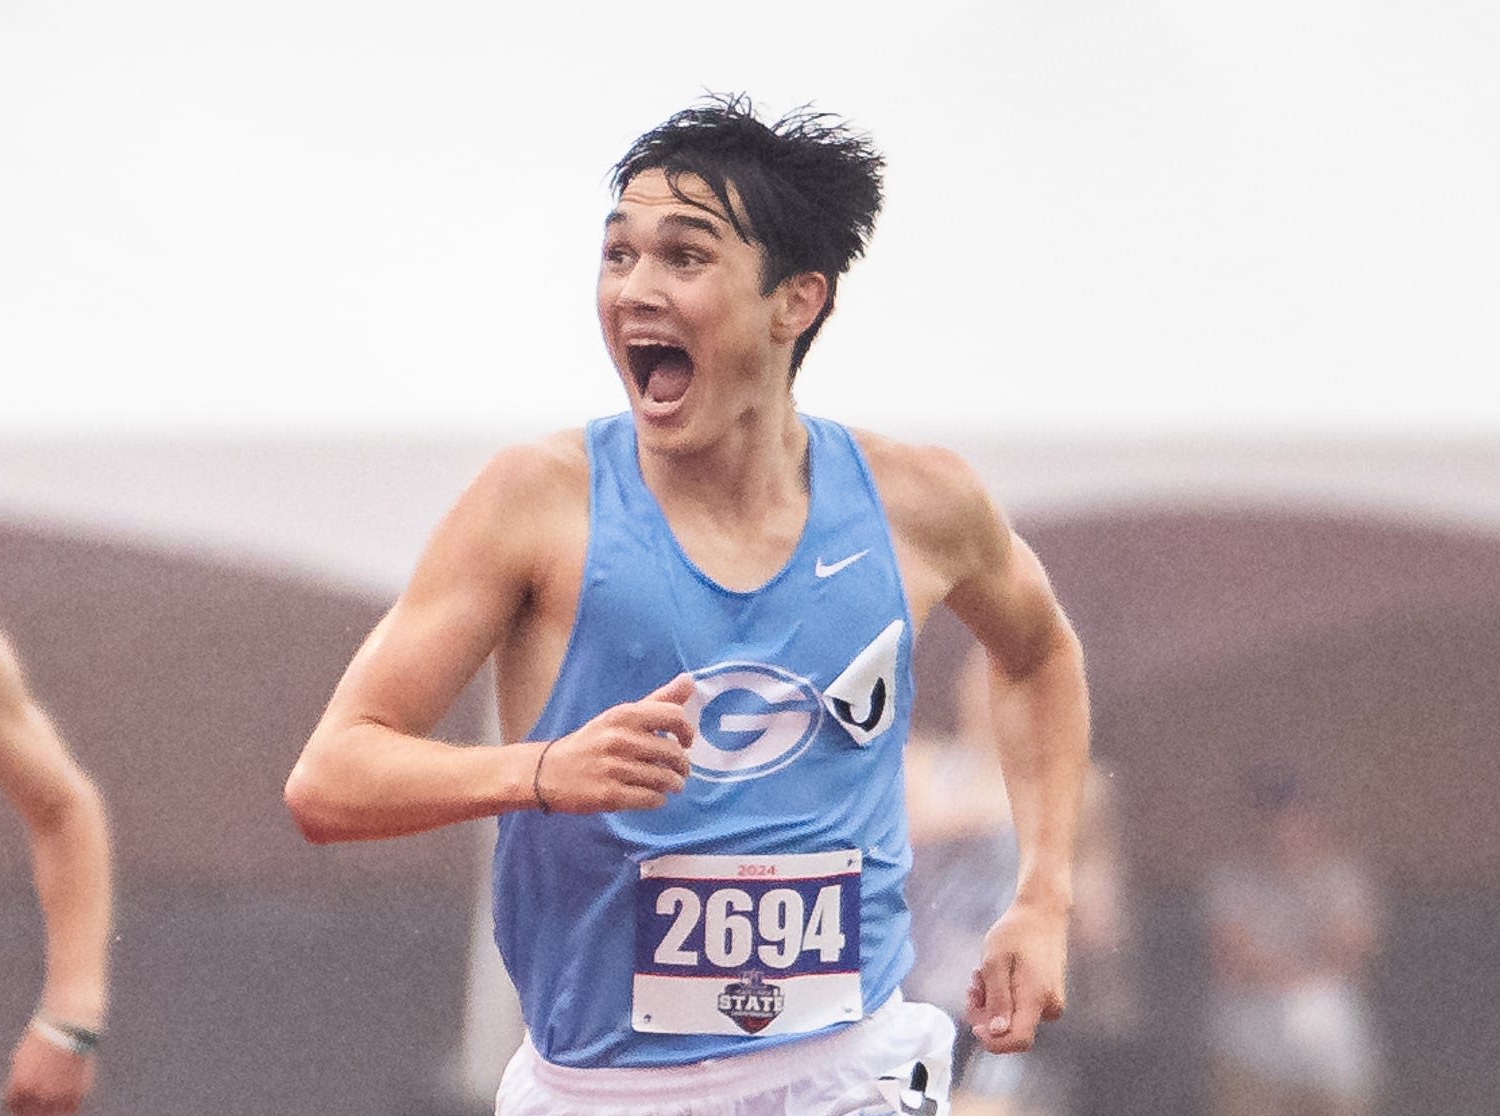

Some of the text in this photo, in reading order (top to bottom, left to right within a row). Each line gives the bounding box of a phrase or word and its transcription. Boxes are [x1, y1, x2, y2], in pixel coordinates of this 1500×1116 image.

[685, 672, 812, 771] G
[736, 864, 778, 876] 2024
[654, 884, 846, 969] 2694
[718, 994, 784, 1012] STATE
